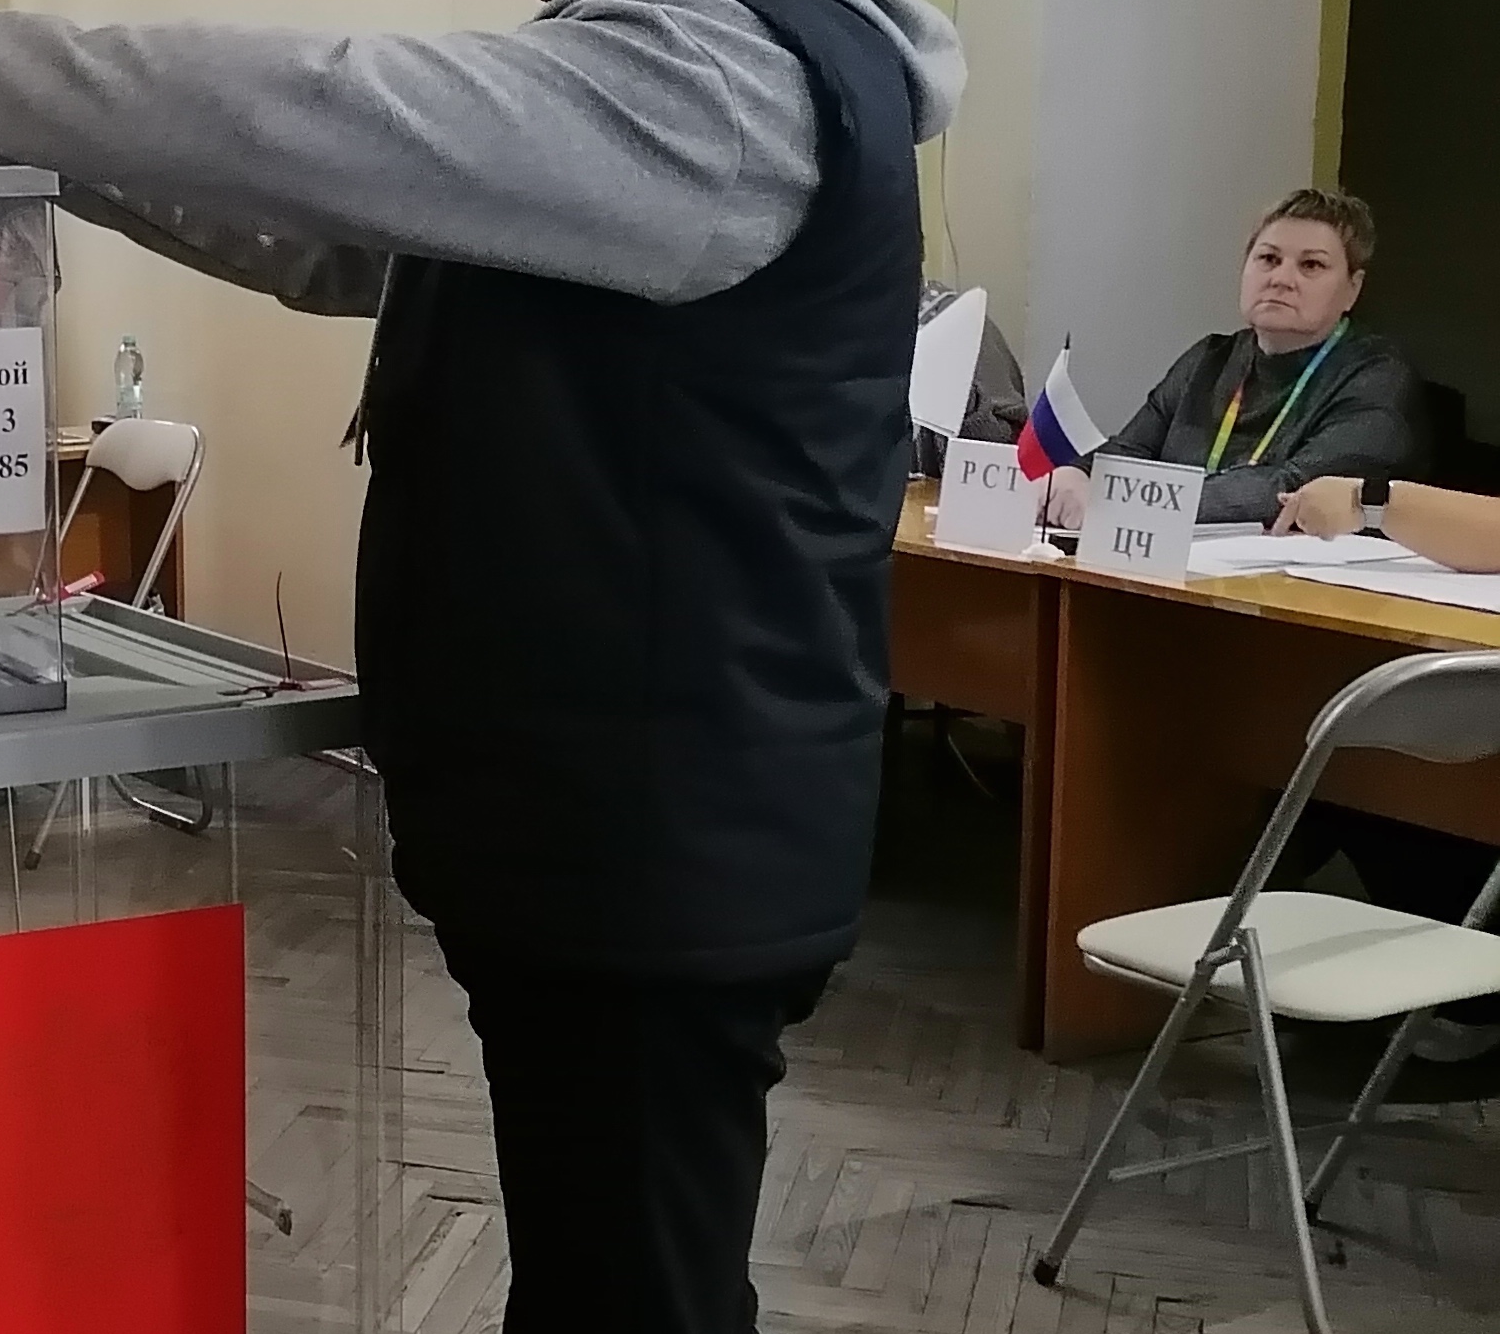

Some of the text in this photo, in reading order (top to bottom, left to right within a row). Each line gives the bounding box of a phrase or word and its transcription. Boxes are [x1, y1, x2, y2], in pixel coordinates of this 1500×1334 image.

[1, 408, 17, 433] 3
[1103, 473, 1186, 512] ТУФХ
[1111, 525, 1155, 562] ЦЧ
